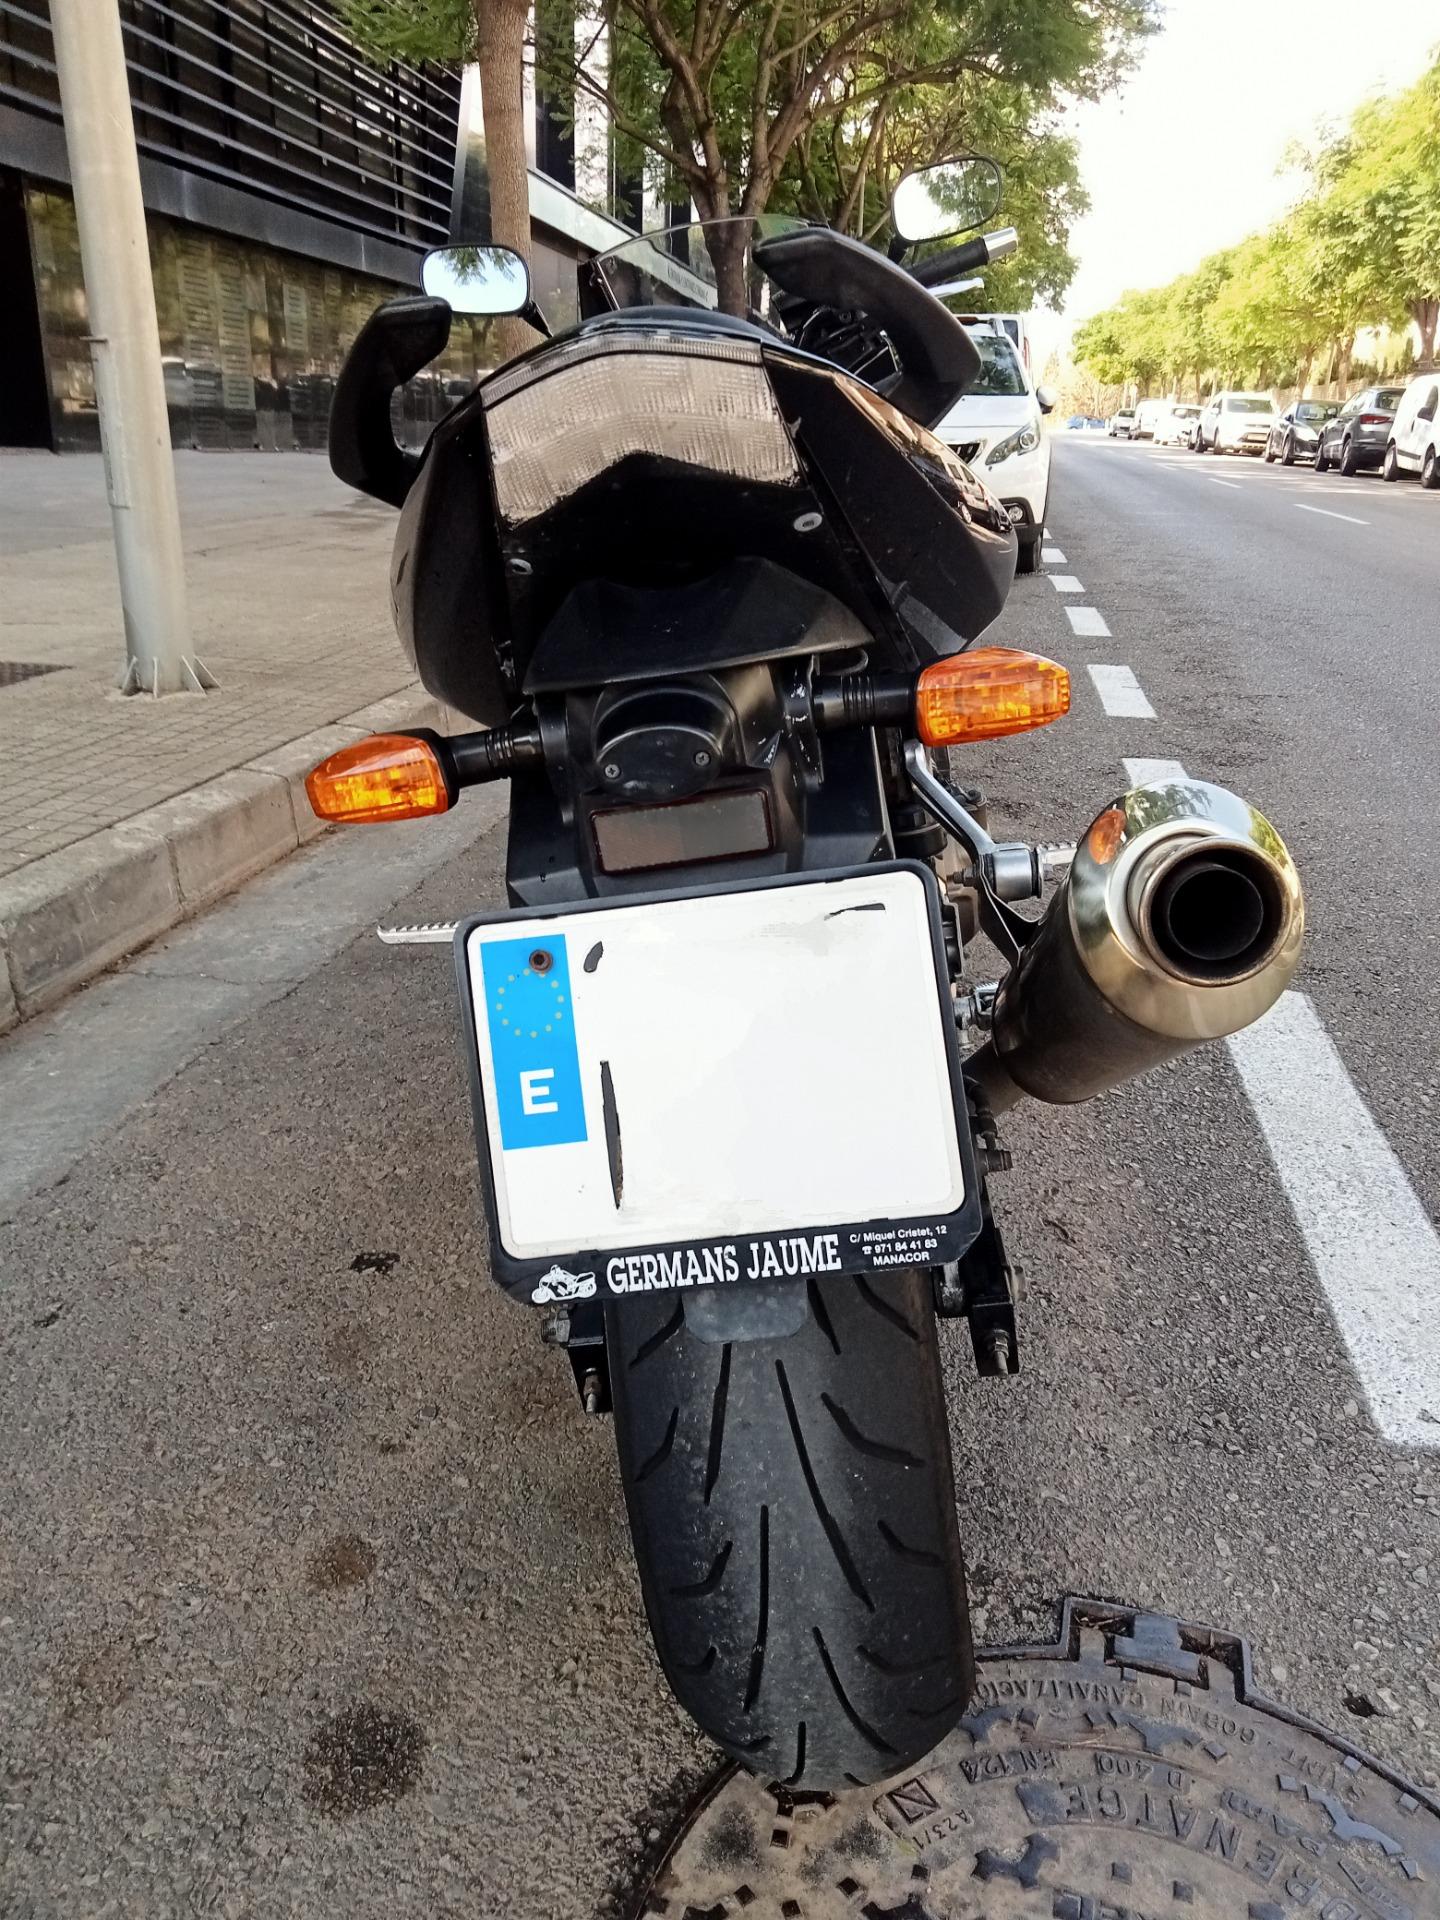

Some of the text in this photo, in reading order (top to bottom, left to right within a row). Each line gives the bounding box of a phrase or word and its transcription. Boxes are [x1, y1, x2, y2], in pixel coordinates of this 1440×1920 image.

[519, 1067, 559, 1116] E
[849, 1233, 861, 1244] C/
[863, 1230, 896, 1242] Miquel
[935, 1224, 948, 1235] 12
[874, 1238, 938, 1254] 971 84 41 83
[606, 1233, 842, 1294] GERMANS JAUME
[872, 1251, 931, 1266] MANACOR
